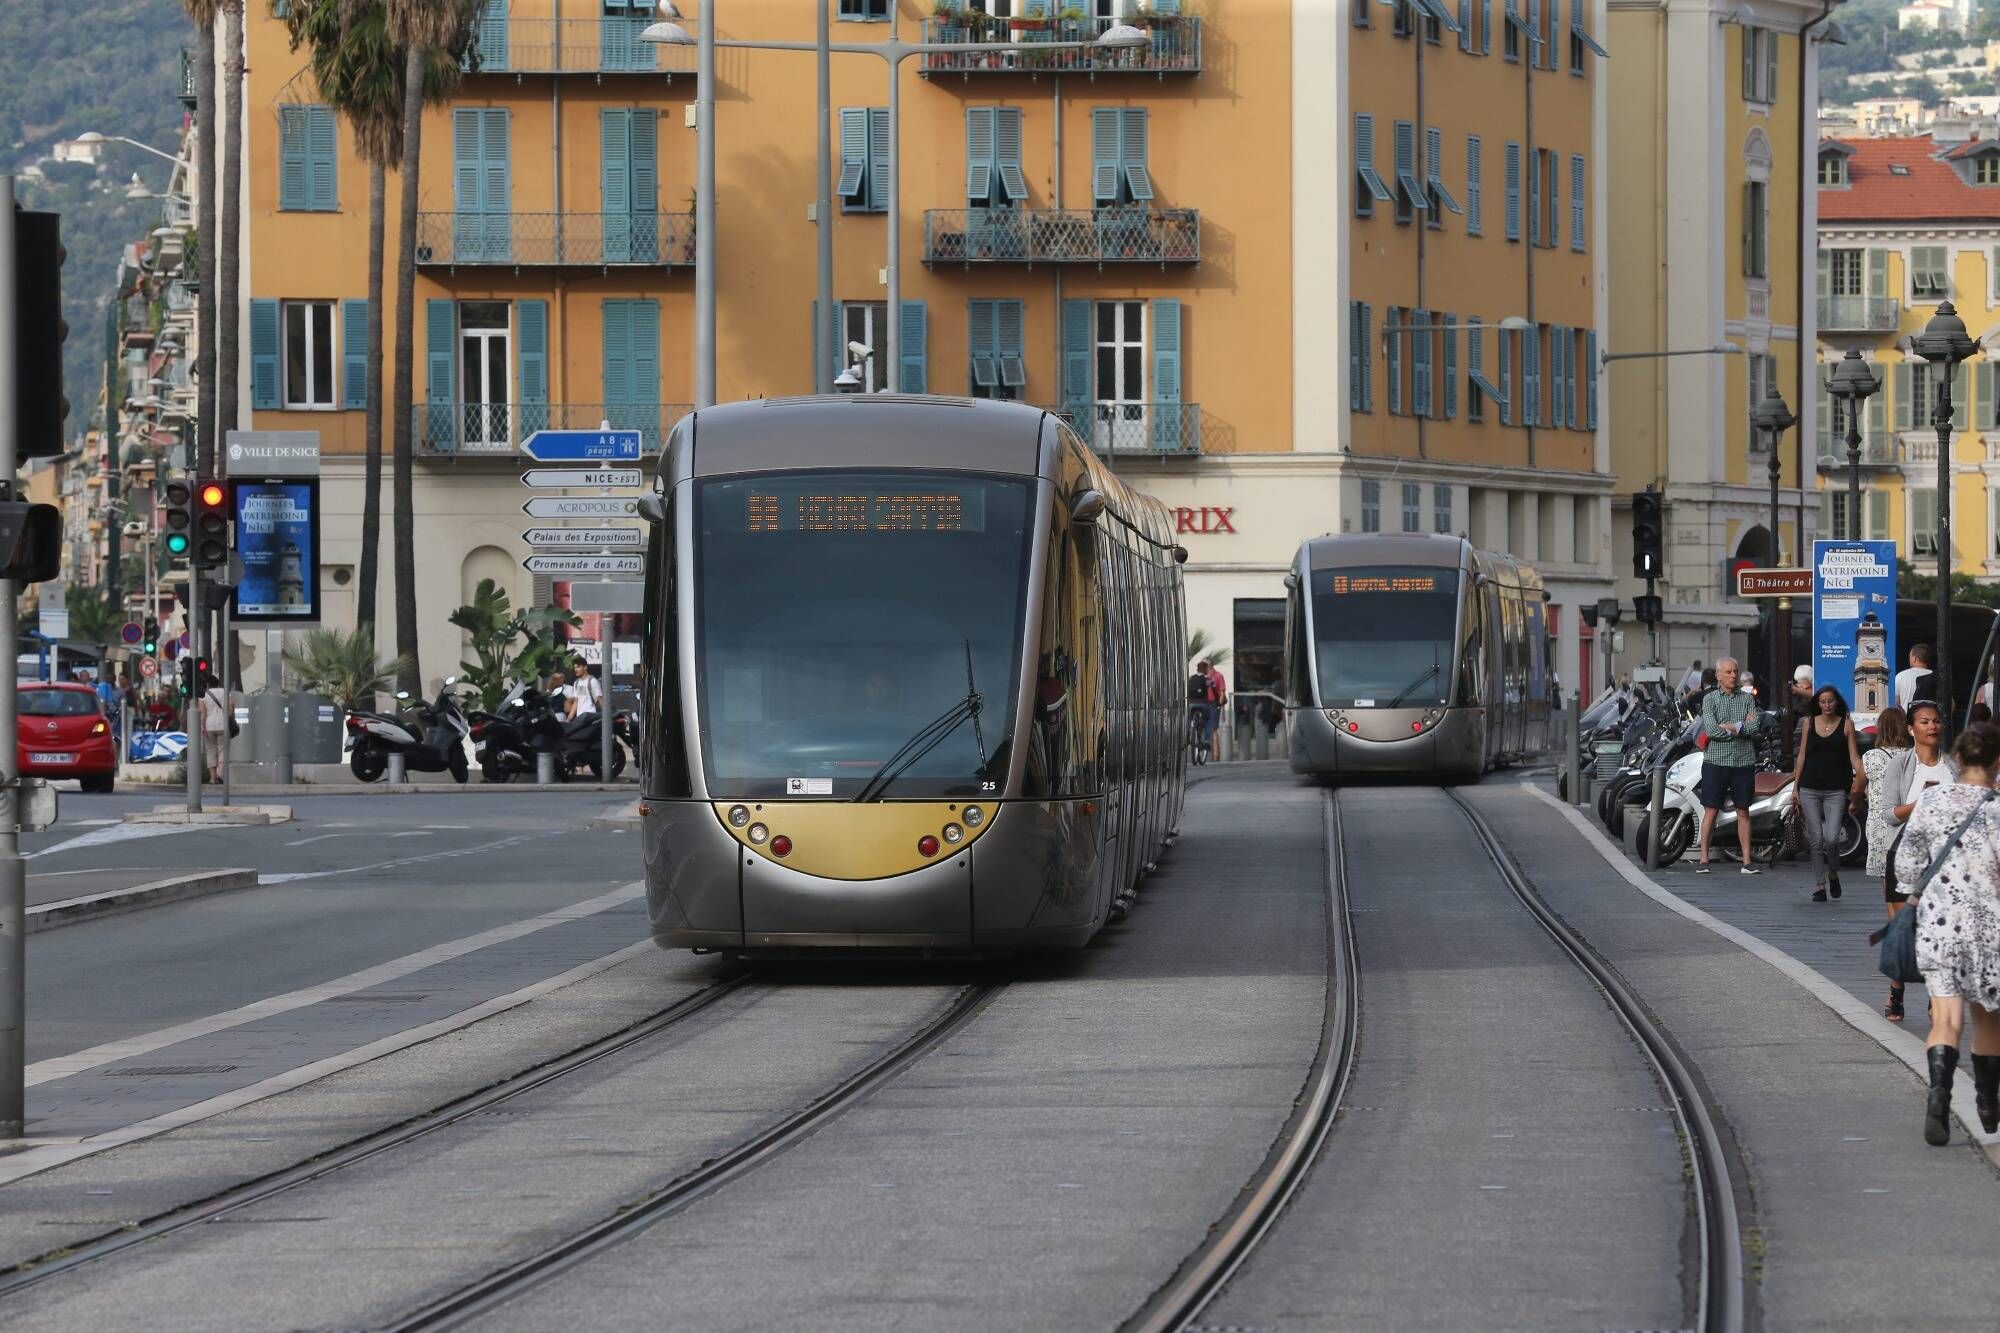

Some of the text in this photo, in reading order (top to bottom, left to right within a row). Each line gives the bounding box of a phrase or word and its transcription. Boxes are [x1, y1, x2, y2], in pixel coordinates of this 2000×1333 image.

[599, 436, 615, 445] A 8
[244, 447, 319, 457] VILLE DE NICE
[585, 474, 636, 483] NICE-EST
[556, 502, 620, 513] ACROPOLIS
[244, 511, 305, 520] PATRIMOINE
[533, 532, 637, 544] Palais des Expositions
[533, 560, 638, 569] Promenade des Arts
[1822, 567, 1887, 576] PATRIMOINE
[1757, 578, 1790, 588] Théâtre
[1794, 578, 1805, 587] de
[982, 782, 996, 790] 25
